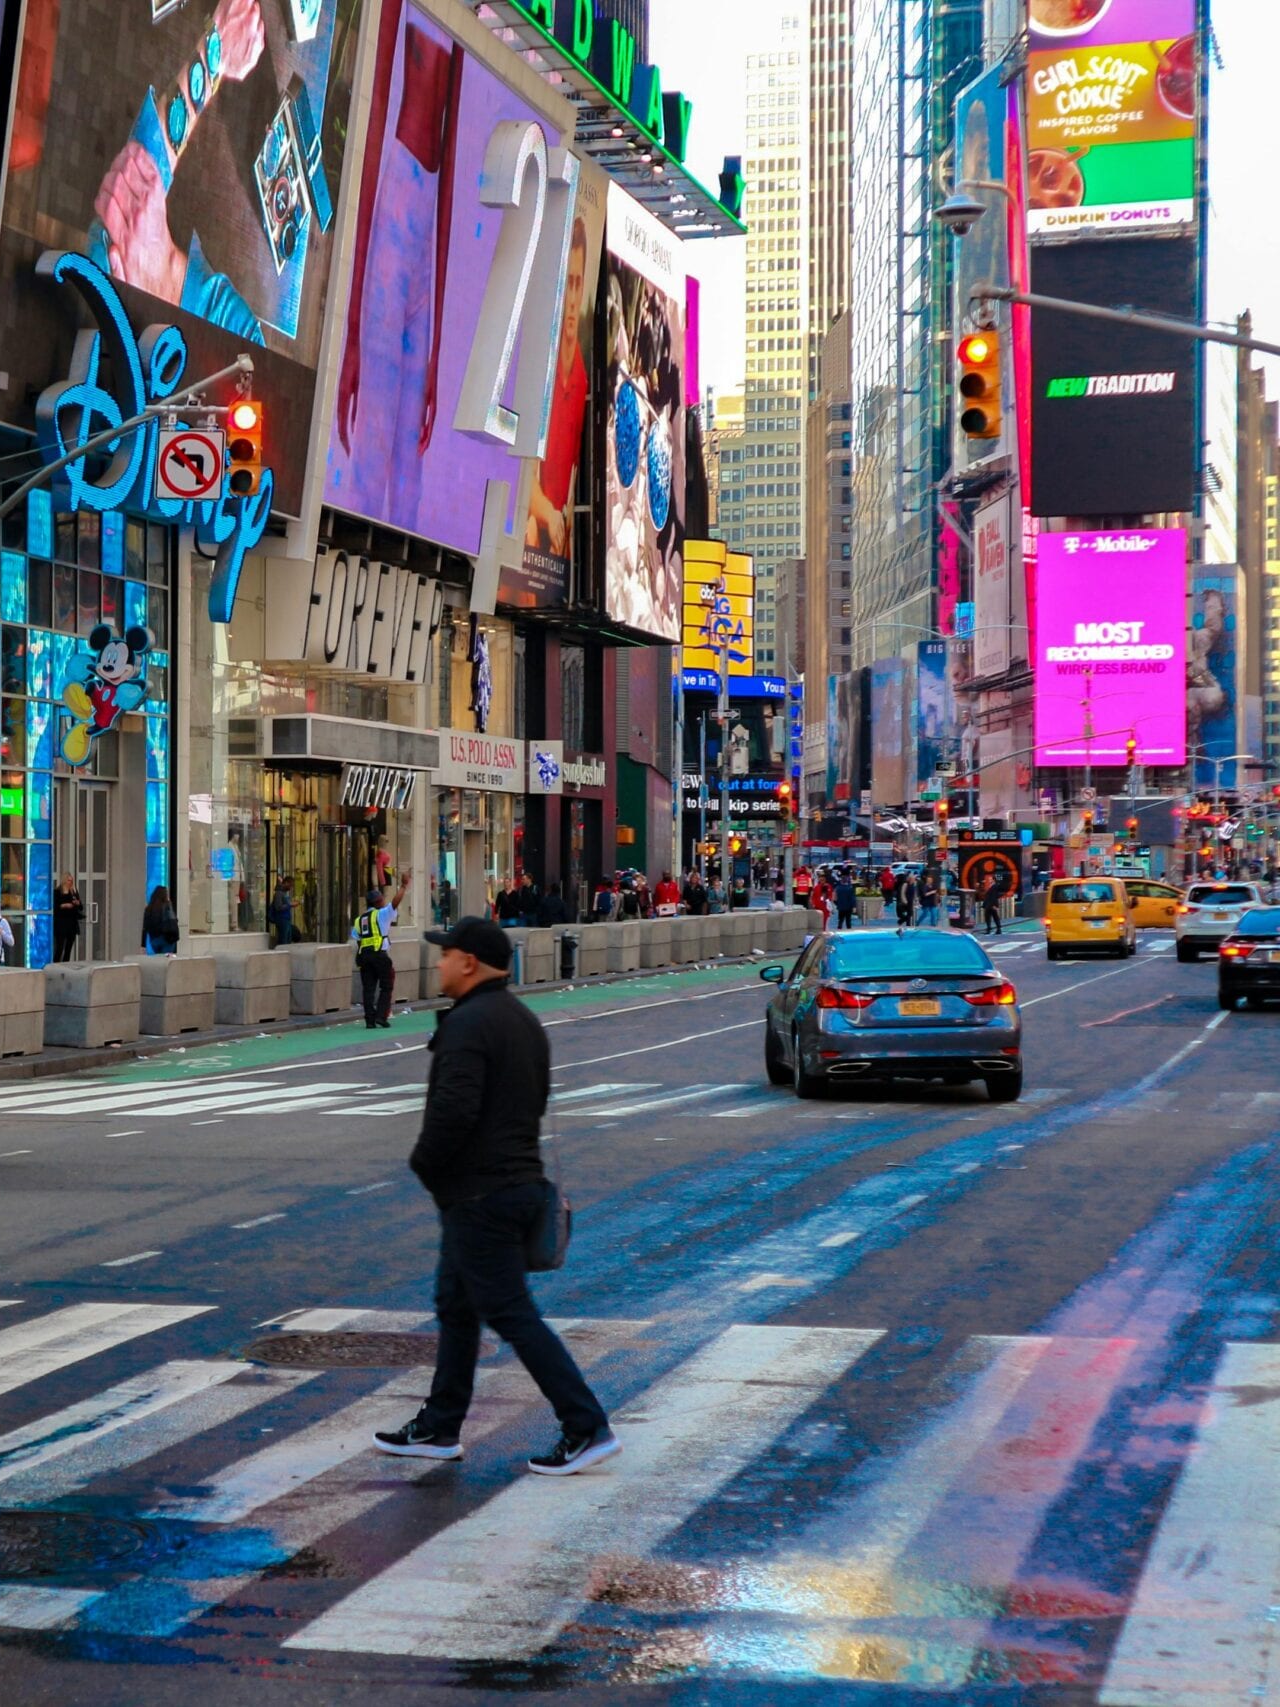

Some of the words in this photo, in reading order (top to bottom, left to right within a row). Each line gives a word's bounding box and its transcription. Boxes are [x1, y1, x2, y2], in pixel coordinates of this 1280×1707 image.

[1033, 62, 1087, 97] GIRL
[1085, 55, 1149, 88] SCOUT
[1056, 85, 1125, 115] COOKIE
[1038, 114, 1093, 129] INSPIRED
[1096, 111, 1145, 124] COFFEE
[1063, 123, 1119, 138] FLAVORS
[1110, 207, 1171, 222] DONUTS
[302, 542, 445, 686] FOREVER
[1074, 622, 1145, 644] MOST
[1046, 644, 1175, 662] RECOMMENDED
[1056, 663, 1118, 676] WIRELESS
[1121, 662, 1166, 674] BRAND
[449, 735, 467, 762] U.S.
[468, 738, 492, 767] POLO
[493, 742, 517, 770] ASSN.
[341, 765, 401, 810] FOREVER
[466, 771, 486, 784] SINCE
[487, 773, 503, 786] 1890
